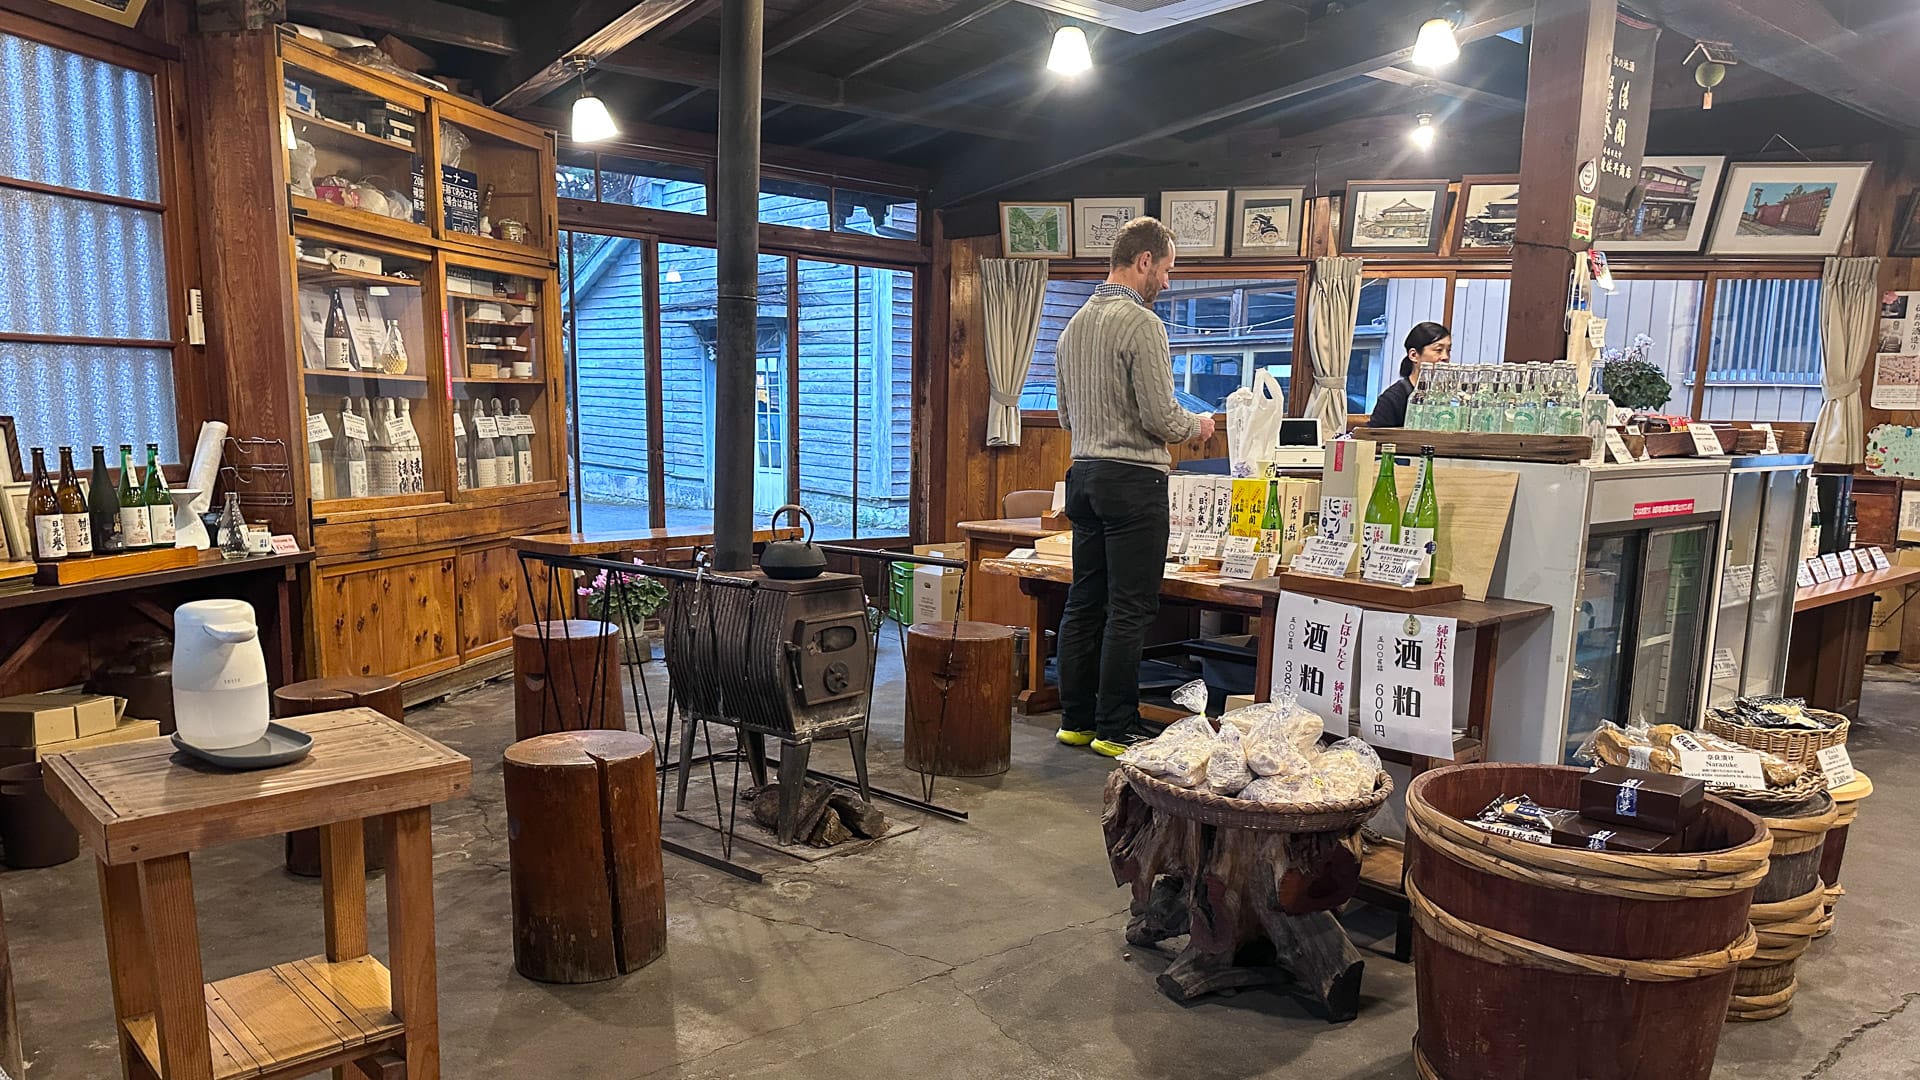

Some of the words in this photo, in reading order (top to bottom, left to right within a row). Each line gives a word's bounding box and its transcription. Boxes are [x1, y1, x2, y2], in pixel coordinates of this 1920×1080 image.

[441, 170, 469, 184] ーナー
[1197, 497, 1206, 526] 日光誉
[1215, 498, 1224, 527] 日光誉
[52, 520, 64, 551] 日光誉
[1311, 555, 1338, 567] ¥1,700
[1299, 619, 1331, 696] 酒粕
[1433, 624, 1449, 688] 純米大吟醸
[1392, 637, 1423, 718] 酒粕
[1333, 680, 1344, 715] 純米酒
[1374, 683, 1386, 738] 600円
